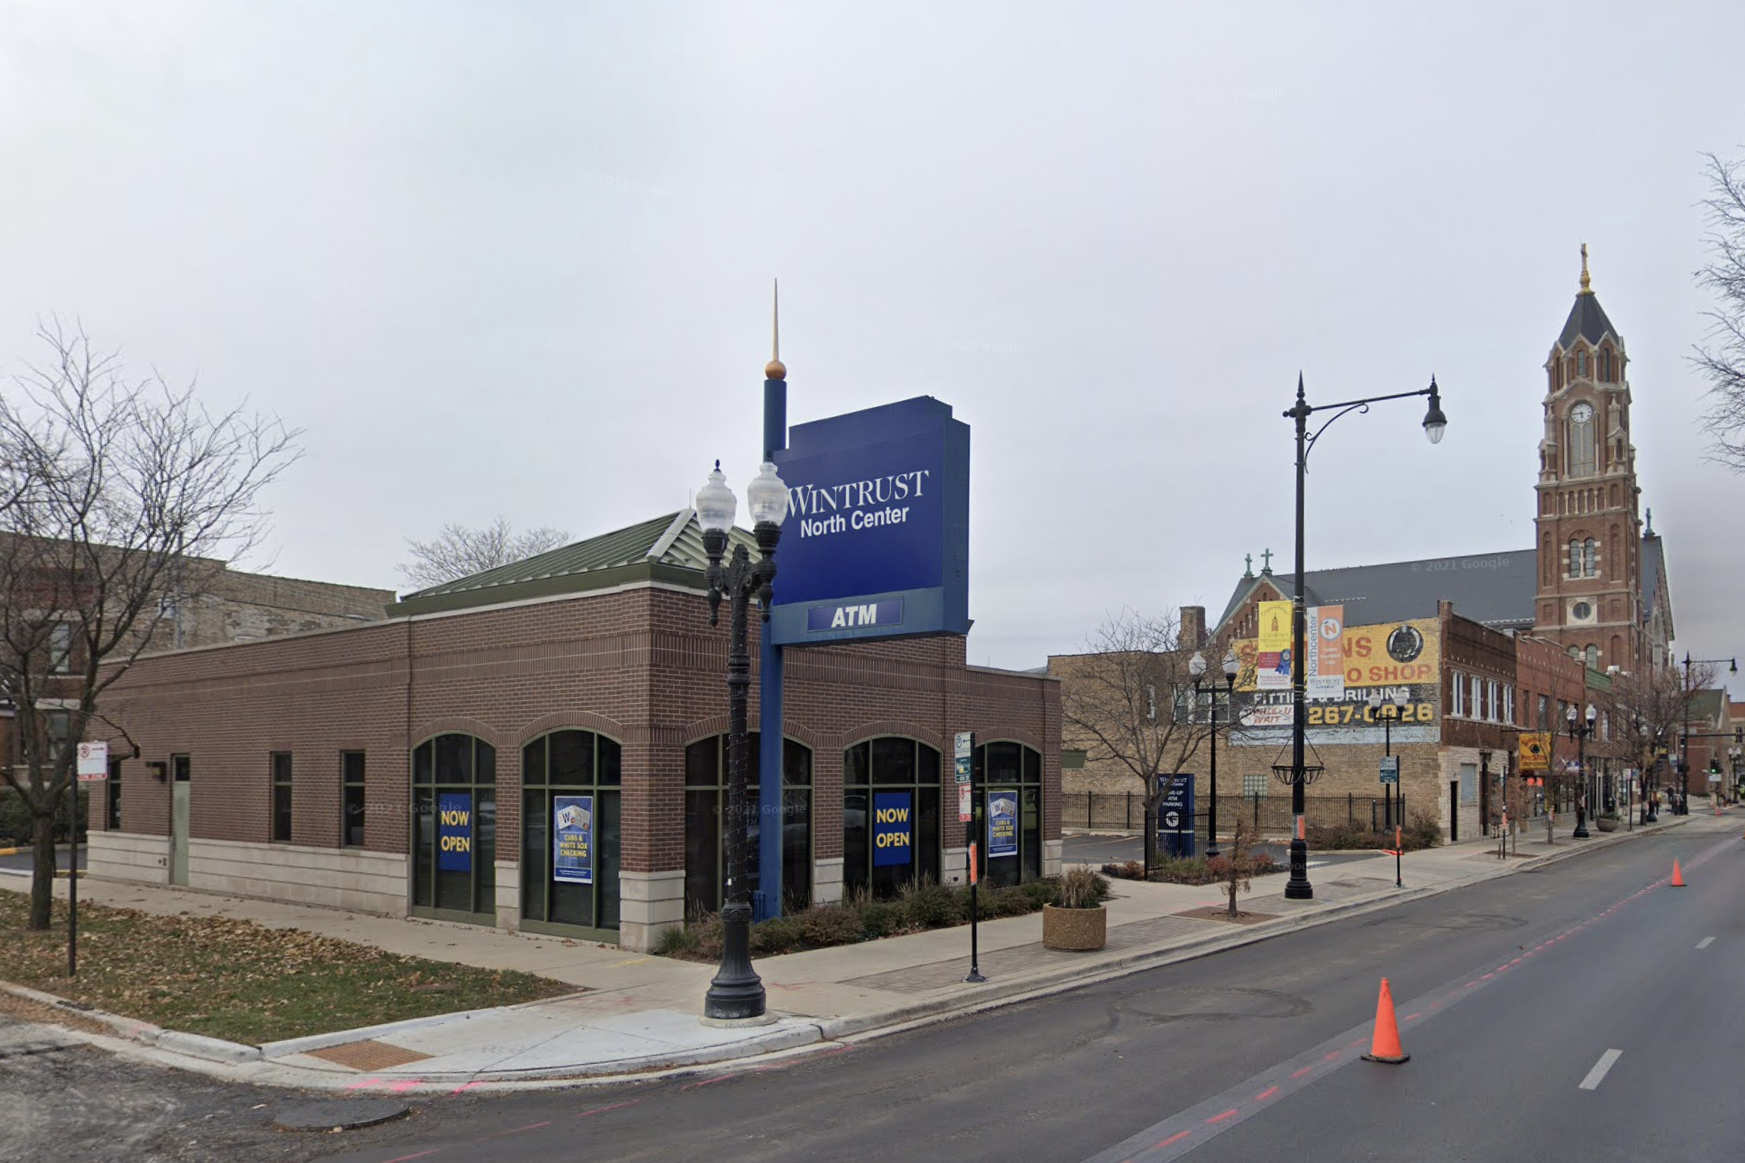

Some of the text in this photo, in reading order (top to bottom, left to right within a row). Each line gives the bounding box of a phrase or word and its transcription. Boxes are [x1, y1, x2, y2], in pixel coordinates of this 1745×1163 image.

[787, 470, 929, 517] WINTRUST
[801, 506, 909, 538] North Center
[831, 603, 877, 628] ATM
[1309, 615, 1318, 677] Northcenter
[1368, 664, 1432, 682] SHOP
[441, 810, 470, 826] NOW
[876, 808, 909, 824] NOW
[441, 836, 470, 852] OPEN
[876, 832, 910, 848] OPEN
